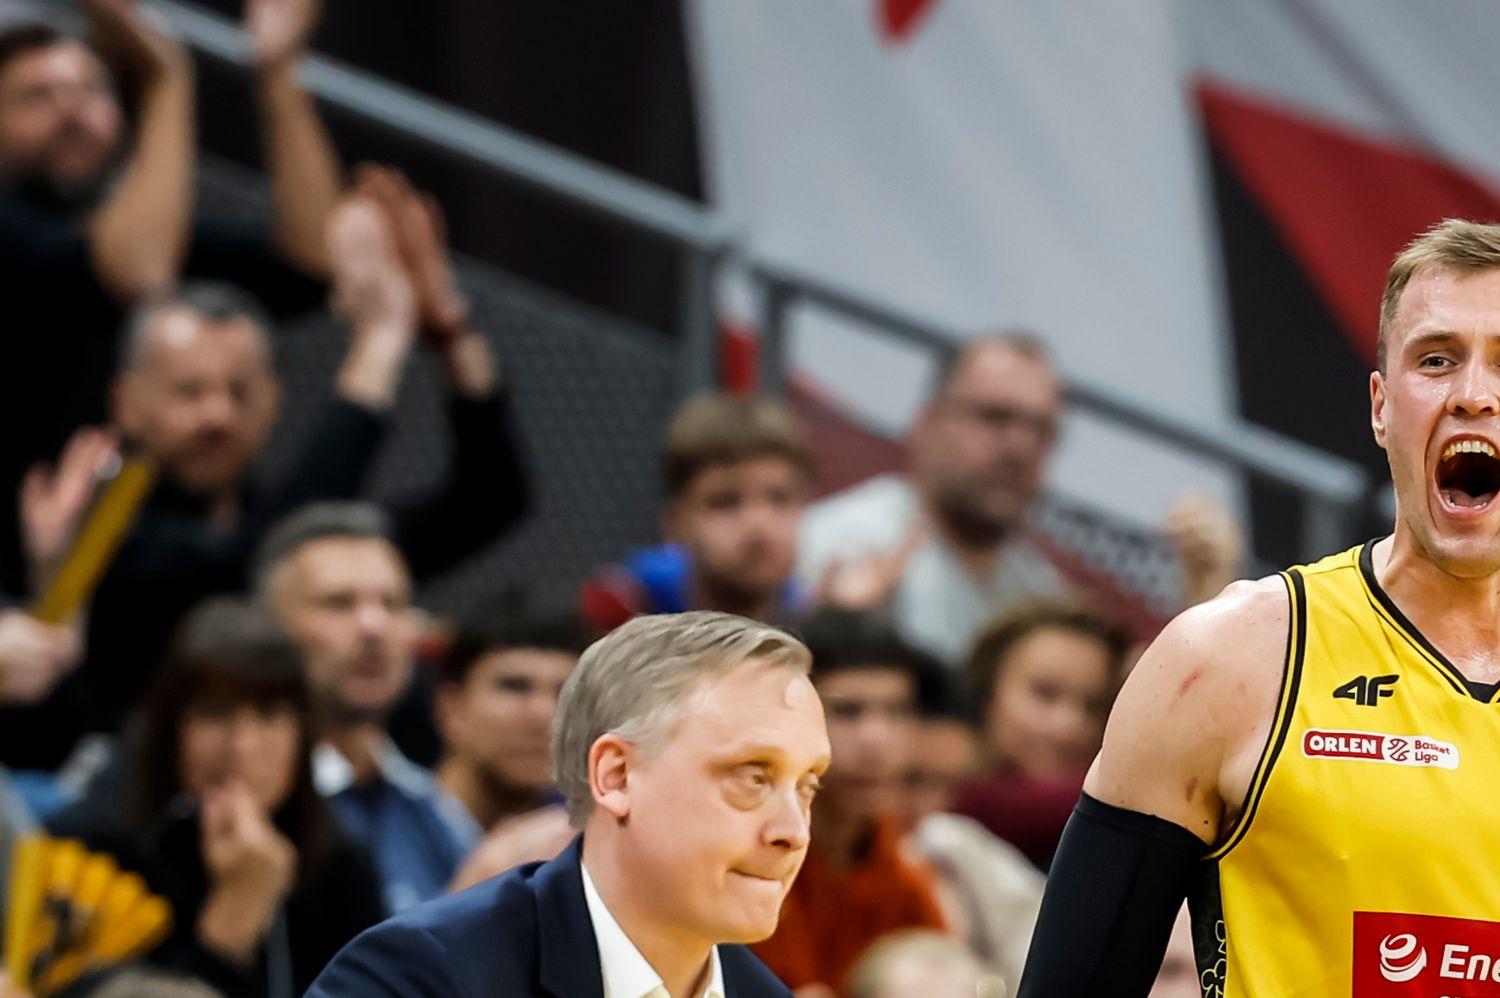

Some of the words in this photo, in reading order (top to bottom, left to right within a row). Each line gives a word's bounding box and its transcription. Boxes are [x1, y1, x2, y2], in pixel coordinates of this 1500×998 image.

[1333, 674, 1400, 706] 4F
[1309, 735, 1377, 754] ORLEN
[1414, 740, 1451, 756] Basket
[1414, 752, 1439, 764] Liga
